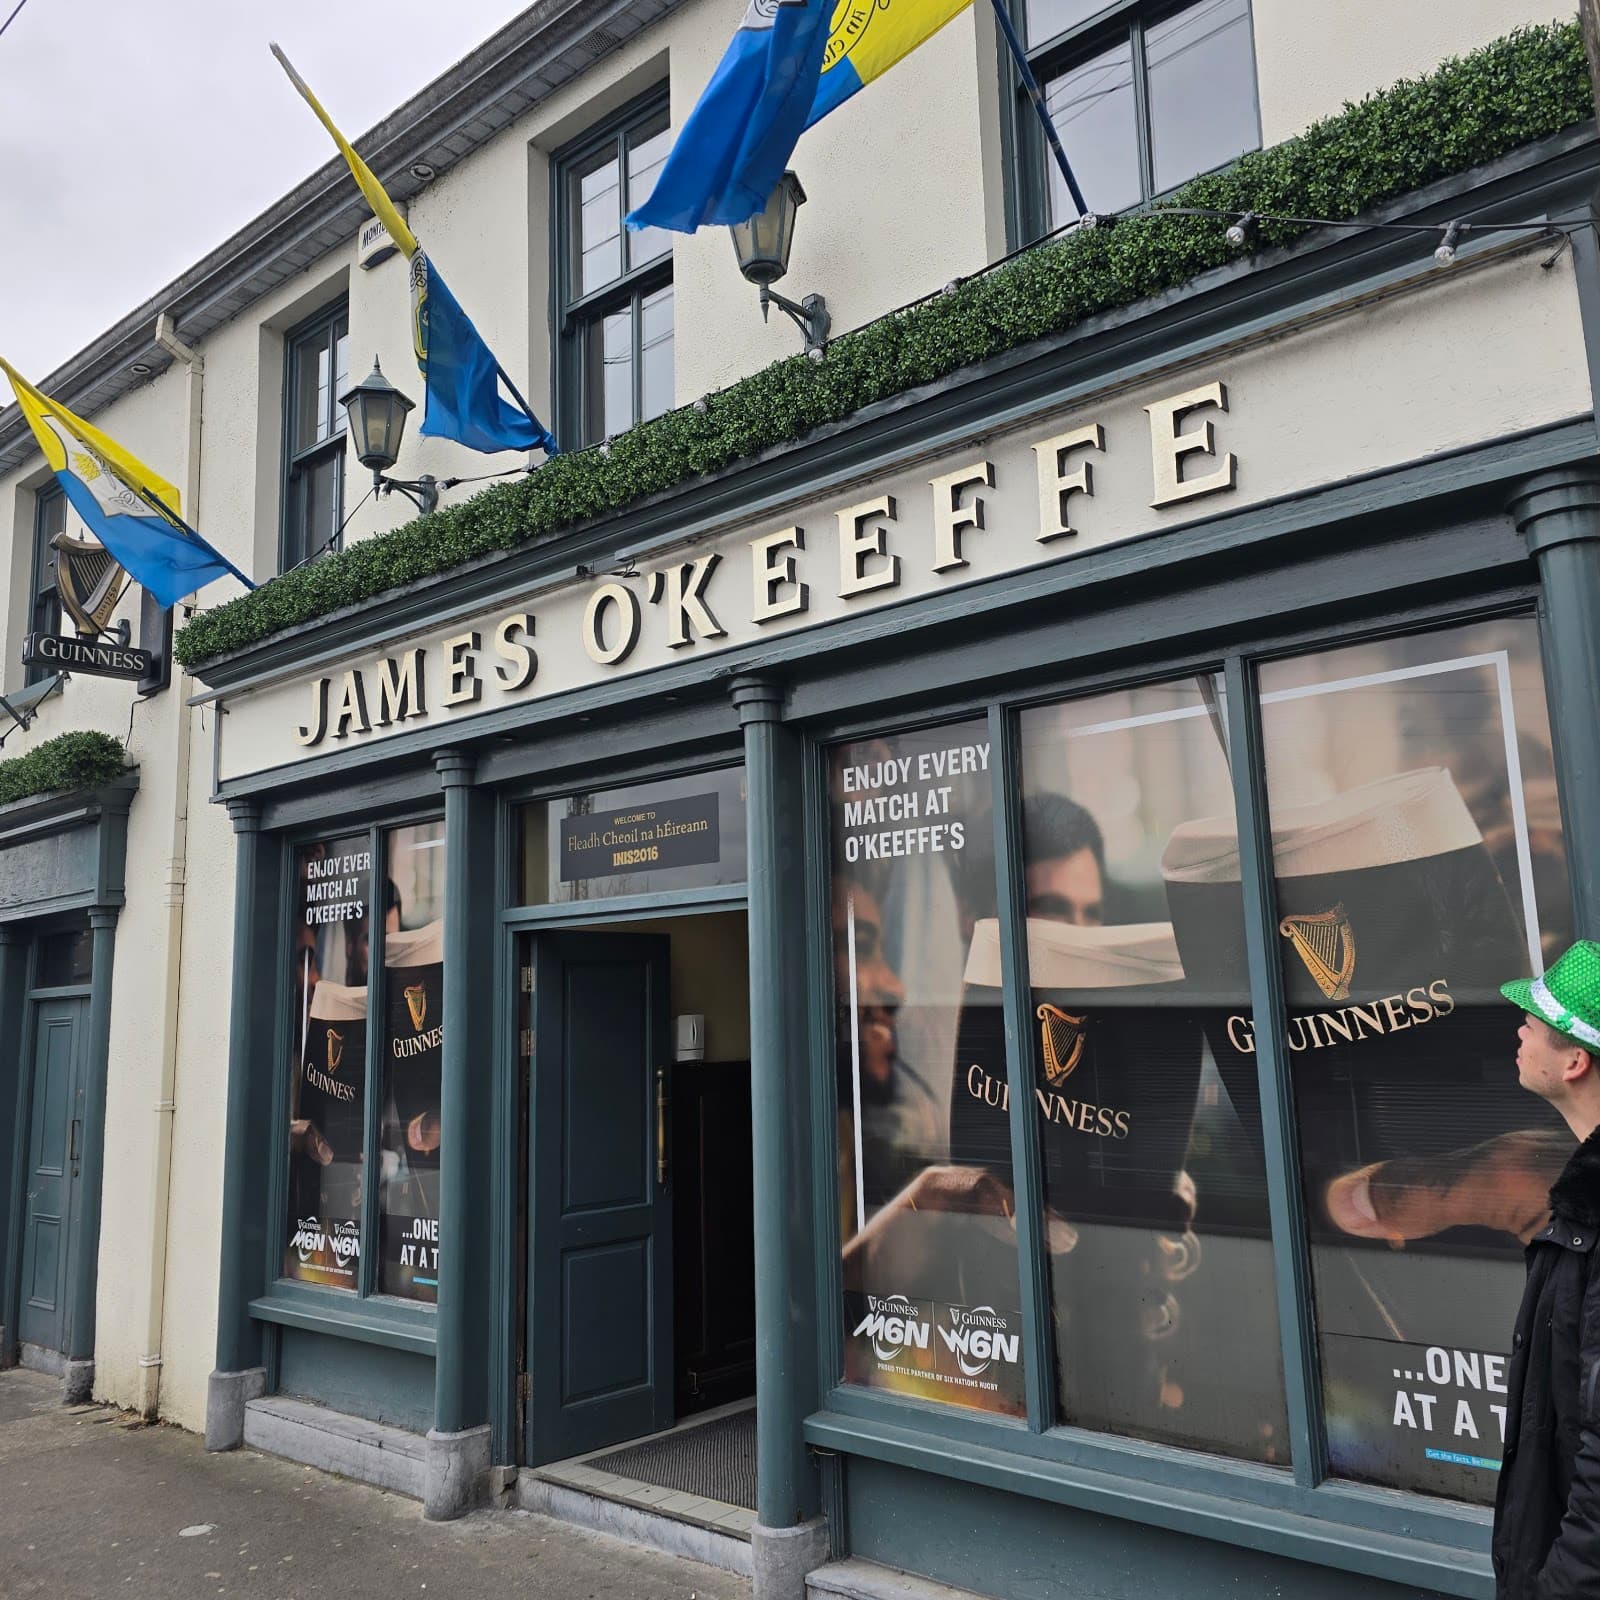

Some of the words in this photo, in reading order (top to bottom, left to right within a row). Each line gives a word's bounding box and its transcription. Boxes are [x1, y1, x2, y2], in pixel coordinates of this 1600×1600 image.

[294, 613, 538, 747] JAMES
[582, 381, 1237, 666] O'KEEFFE
[39, 637, 145, 671] GUINNESS
[843, 756, 912, 793] ENJOY
[918, 742, 991, 781] EVERY
[614, 812, 646, 825] WELCOME
[647, 811, 656, 820] TO
[844, 791, 919, 828] MATCH
[925, 786, 952, 816] AT
[568, 832, 600, 852] Fleadh
[602, 828, 638, 847] Cheoil
[641, 830, 653, 842] na
[656, 818, 708, 839] hÉireann
[845, 822, 965, 863] O'KEEFFE'S
[307, 856, 341, 880] ENJOY
[343, 852, 371, 874] EVER
[613, 845, 659, 867] INIS2016
[306, 879, 343, 903] MATCH
[345, 877, 359, 897] AT
[306, 900, 364, 926] O'KEEFFE'S
[306, 1062, 356, 1102] GUINNESS
[399, 1244, 417, 1267] AT
[418, 1246, 428, 1269] A
[877, 1299, 919, 1317] GUINNESS
[961, 1312, 1007, 1329] GUINNESS
[896, 1366, 910, 1376] TITLE
[911, 1368, 935, 1381] PARTNER
[936, 1374, 943, 1382] OF
[944, 1375, 953, 1384] SIX
[954, 1377, 979, 1389] NATIONS
[1393, 1346, 1508, 1394] ...ONE
[1393, 1390, 1438, 1431] AT
[1454, 1399, 1480, 1439] A
